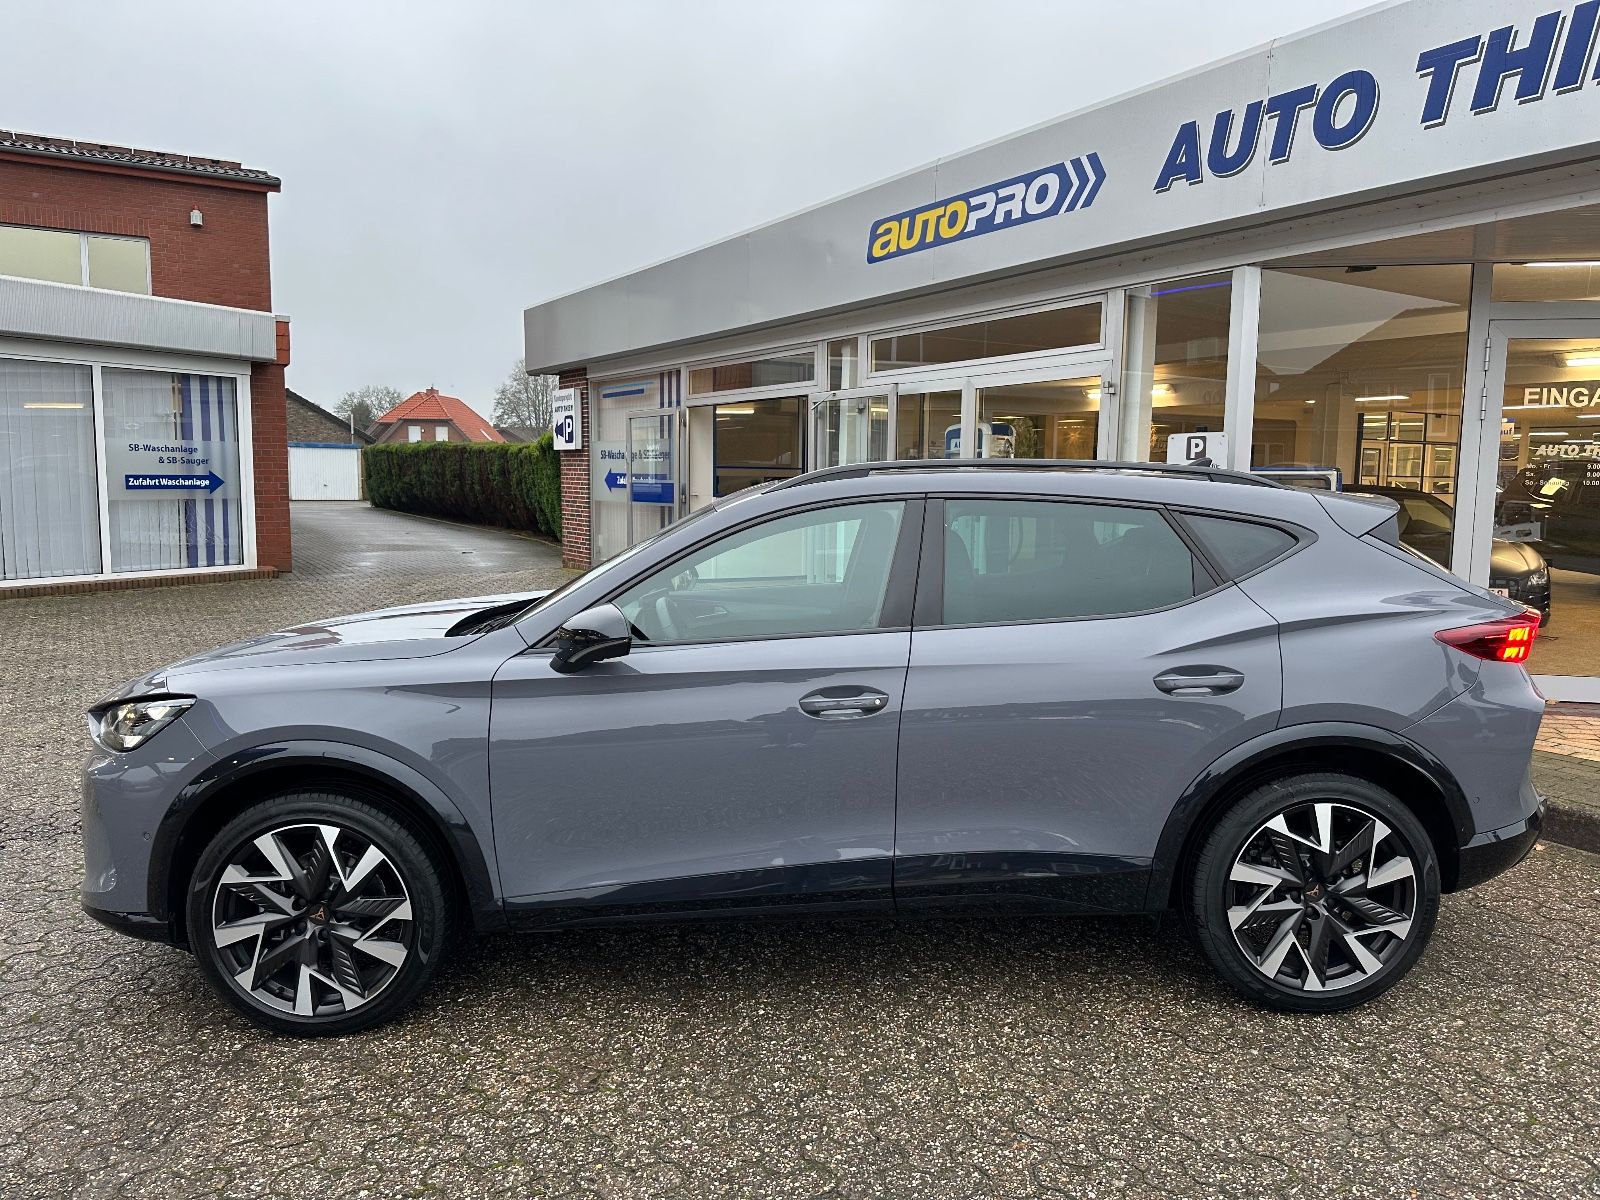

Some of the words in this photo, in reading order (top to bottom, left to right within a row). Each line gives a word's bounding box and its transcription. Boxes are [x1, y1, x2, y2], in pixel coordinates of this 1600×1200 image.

[1153, 69, 1380, 194] AUTO
[1415, 0, 1600, 131] THI
[566, 418, 572, 440] P
[128, 444, 198, 454] SB-Waschanlage
[1190, 438, 1204, 458] P
[1535, 444, 1580, 457] AUTO
[158, 456, 164, 464] &
[166, 456, 209, 466] SB-Sauger
[160, 478, 210, 486] Waschanlage
